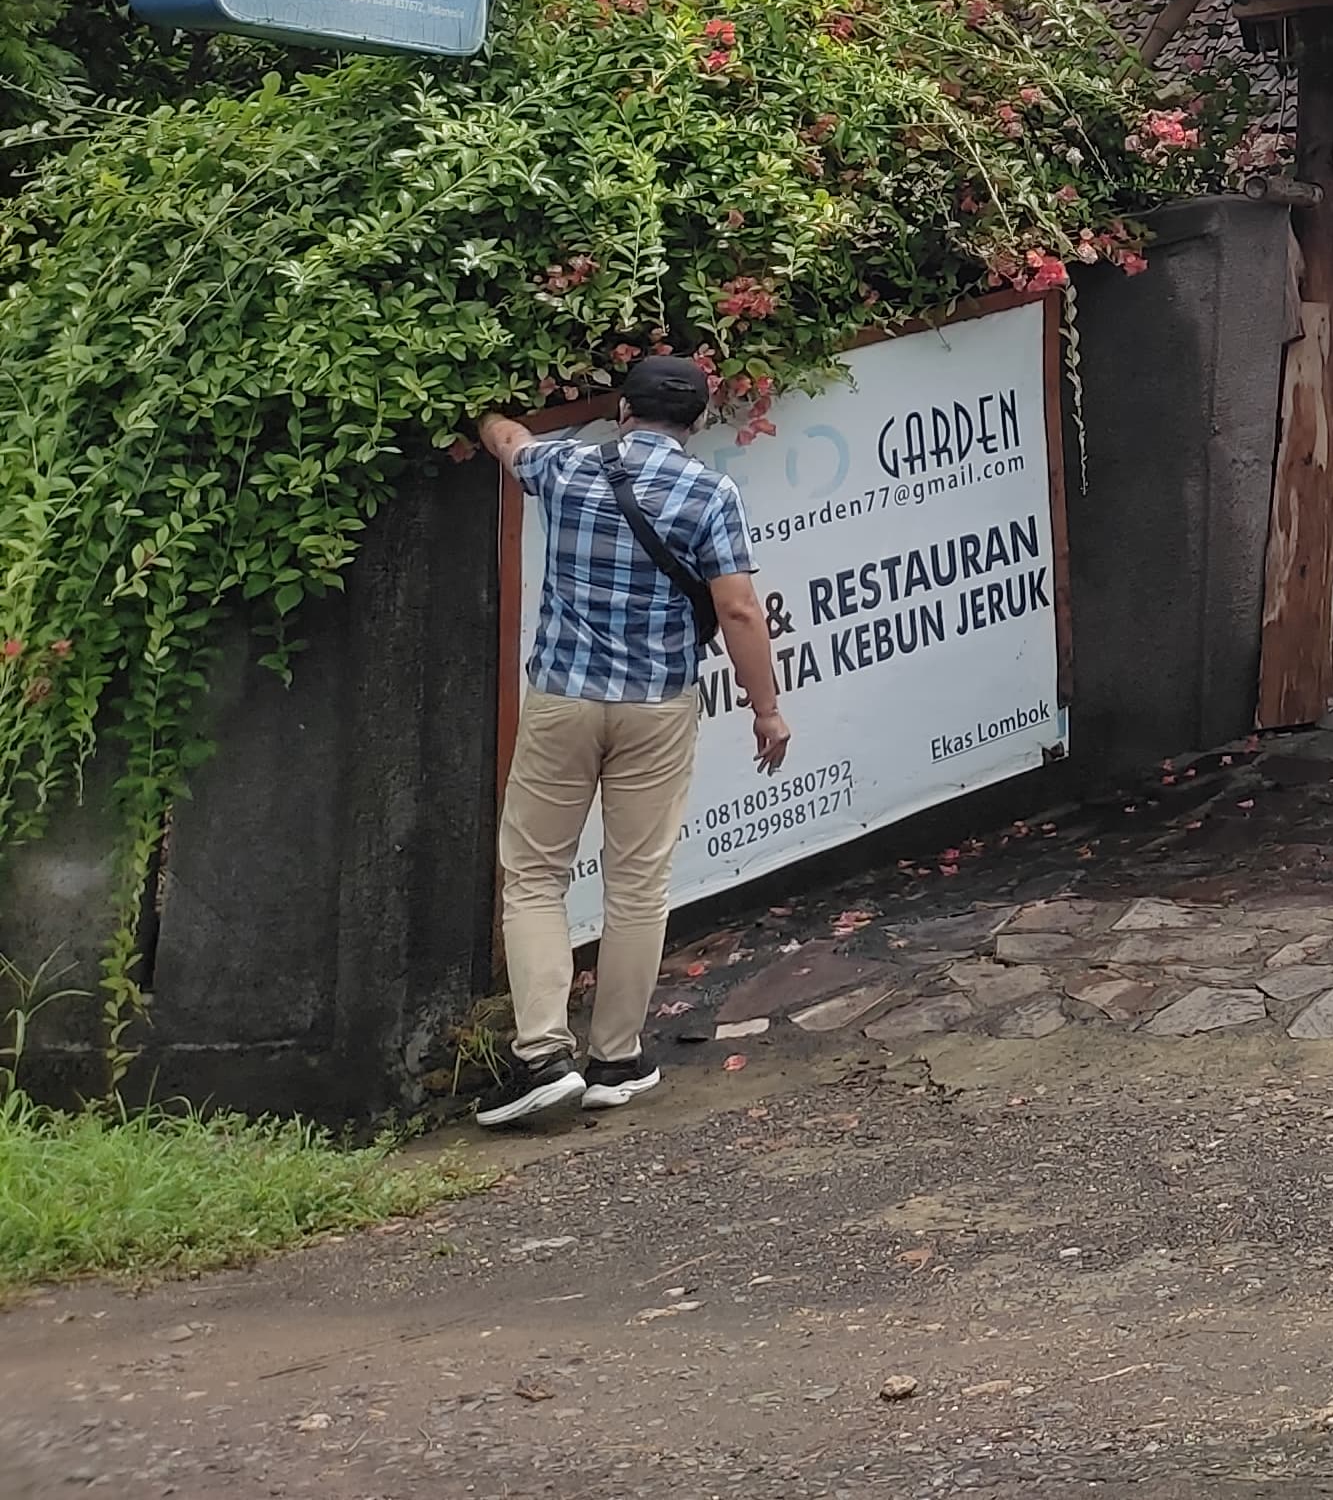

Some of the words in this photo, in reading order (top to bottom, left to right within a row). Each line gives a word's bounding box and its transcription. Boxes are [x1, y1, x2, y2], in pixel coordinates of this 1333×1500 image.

[877, 389, 1021, 480] GARDEN
[750, 453, 1026, 546] asgarden77@gmail.com
[764, 590, 796, 640] &
[808, 514, 1041, 626] RESTAURAN
[831, 600, 945, 677] KEBUN
[956, 566, 1051, 637] JERUK
[931, 731, 973, 761] Ekas
[977, 699, 1051, 744] Lombok
[705, 759, 853, 831] 081803580792
[706, 786, 853, 859] 082299881271
